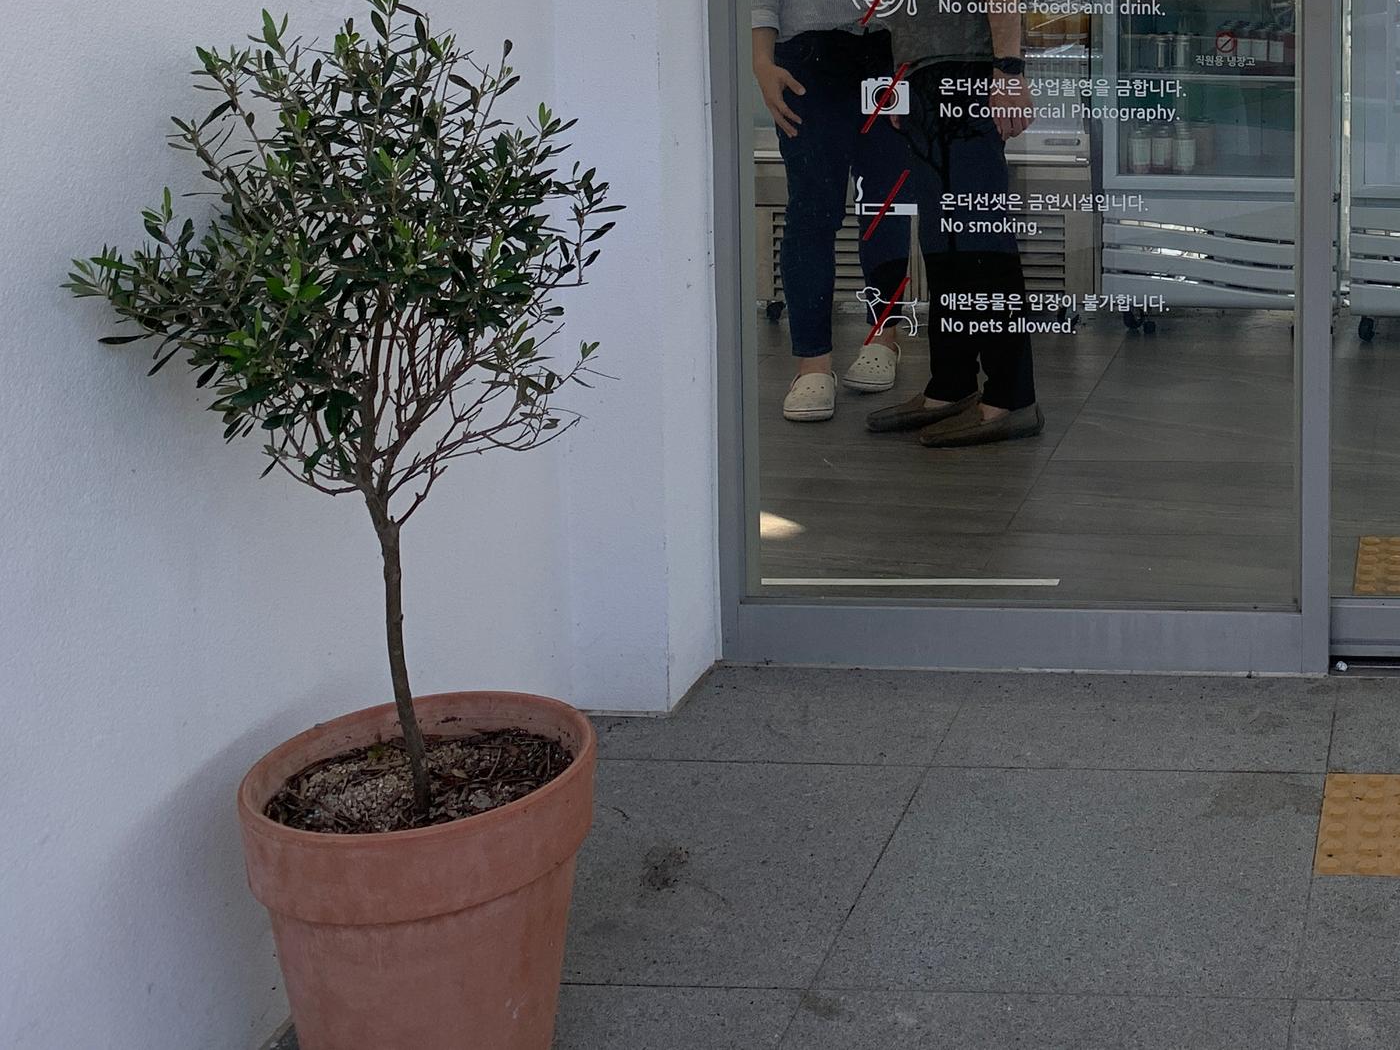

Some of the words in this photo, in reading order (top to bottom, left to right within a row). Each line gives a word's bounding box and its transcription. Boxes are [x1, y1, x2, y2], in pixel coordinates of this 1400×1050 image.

[1083, 0, 1116, 16] and
[1194, 56, 1223, 67] 직원용
[1226, 56, 1256, 67] 냉장고
[939, 78, 1023, 96] 온더선셋은
[1027, 78, 1111, 97] 상업촬영을
[1115, 79, 1187, 98] 금합니다.
[939, 102, 963, 119] No
[968, 102, 1066, 119] Commercial
[1071, 103, 1181, 123] Photography.
[939, 193, 1023, 211] 온더선셋은
[1028, 193, 1149, 212] 금연시설입니다.
[940, 217, 963, 233] No
[968, 217, 1043, 236] smoking.
[940, 293, 1023, 311] 애완동물은
[1028, 293, 1077, 312] 입장이
[1082, 293, 1170, 313] 불가합니다.
[940, 317, 963, 333] No
[968, 317, 1003, 336] pets
[1008, 317, 1077, 334] allowed.
